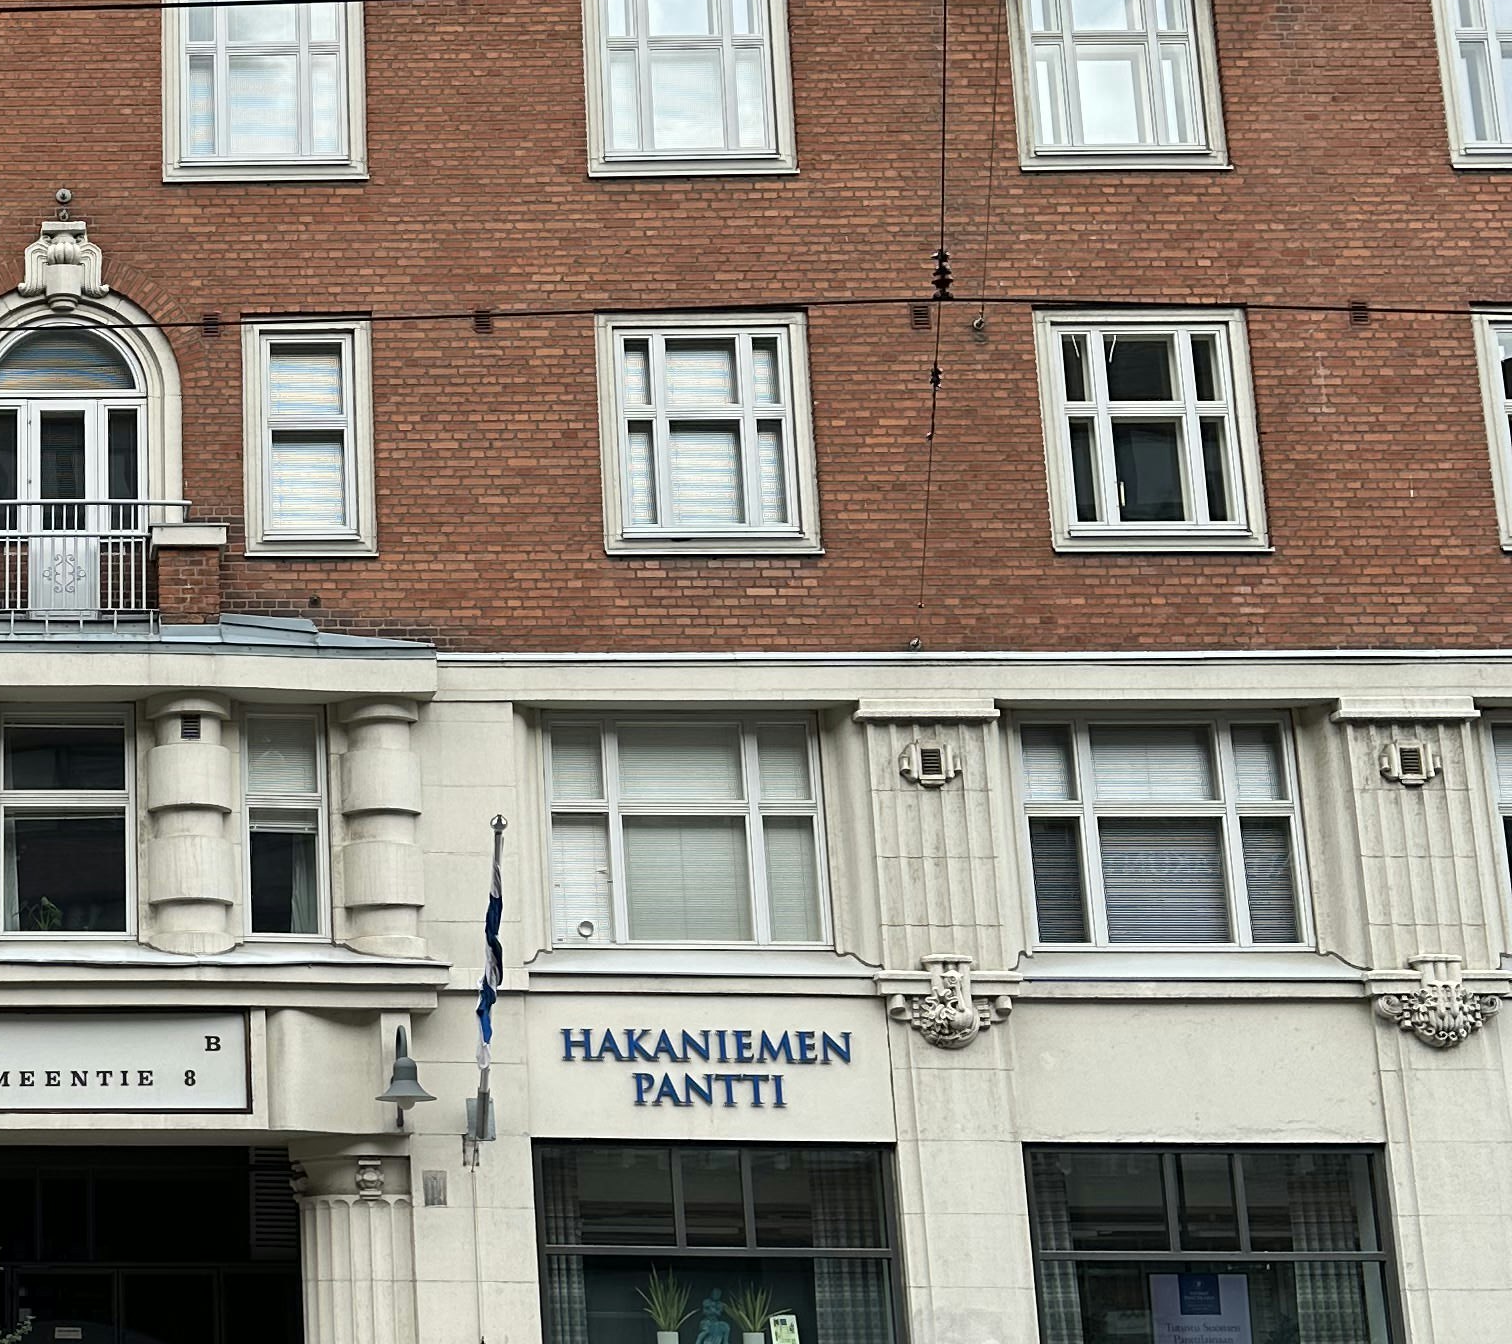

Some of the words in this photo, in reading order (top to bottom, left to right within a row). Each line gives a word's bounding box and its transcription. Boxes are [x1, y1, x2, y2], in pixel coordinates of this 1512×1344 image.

[204, 1035, 222, 1052] B
[560, 1027, 852, 1064] HAKANIEMEN
[184, 1069, 197, 1087] 8
[631, 1072, 788, 1107] PANTTI
